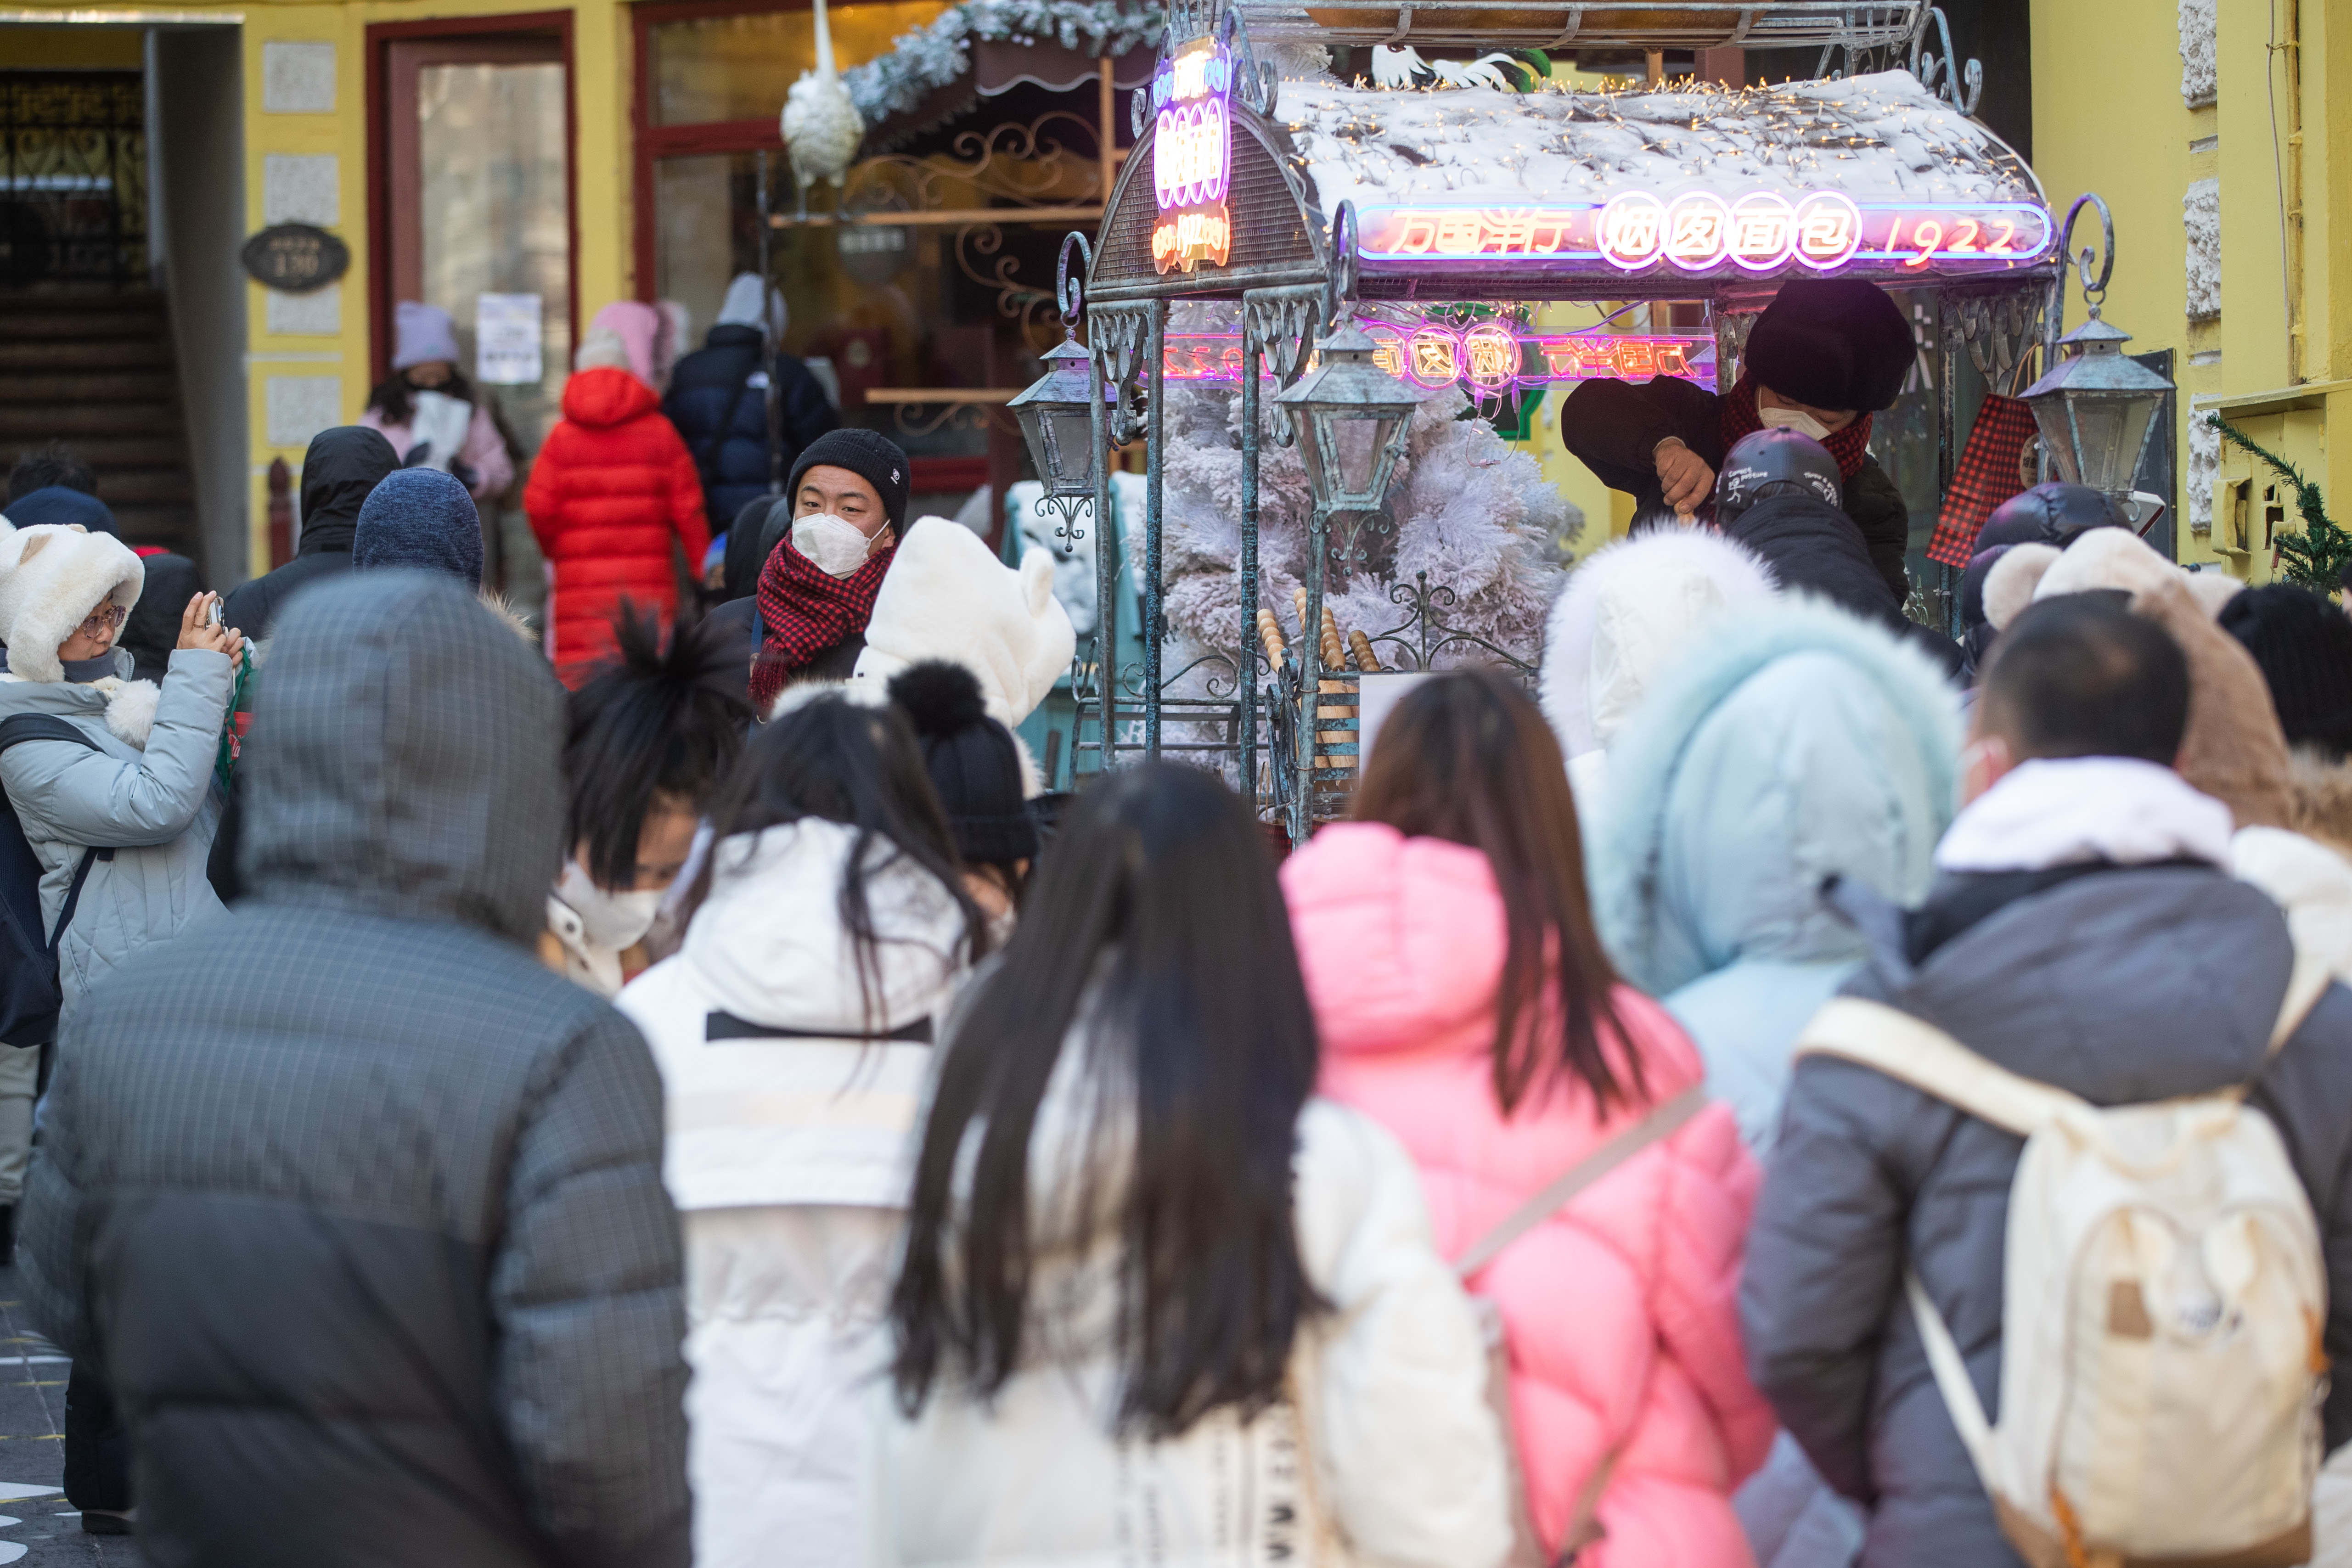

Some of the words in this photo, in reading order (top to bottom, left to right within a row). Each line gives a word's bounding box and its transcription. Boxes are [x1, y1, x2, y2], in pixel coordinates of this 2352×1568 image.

[1388, 207, 1572, 256] 万国洋行
[1605, 202, 1851, 256] 烟囱面包
[1885, 217, 2014, 267] 1922
